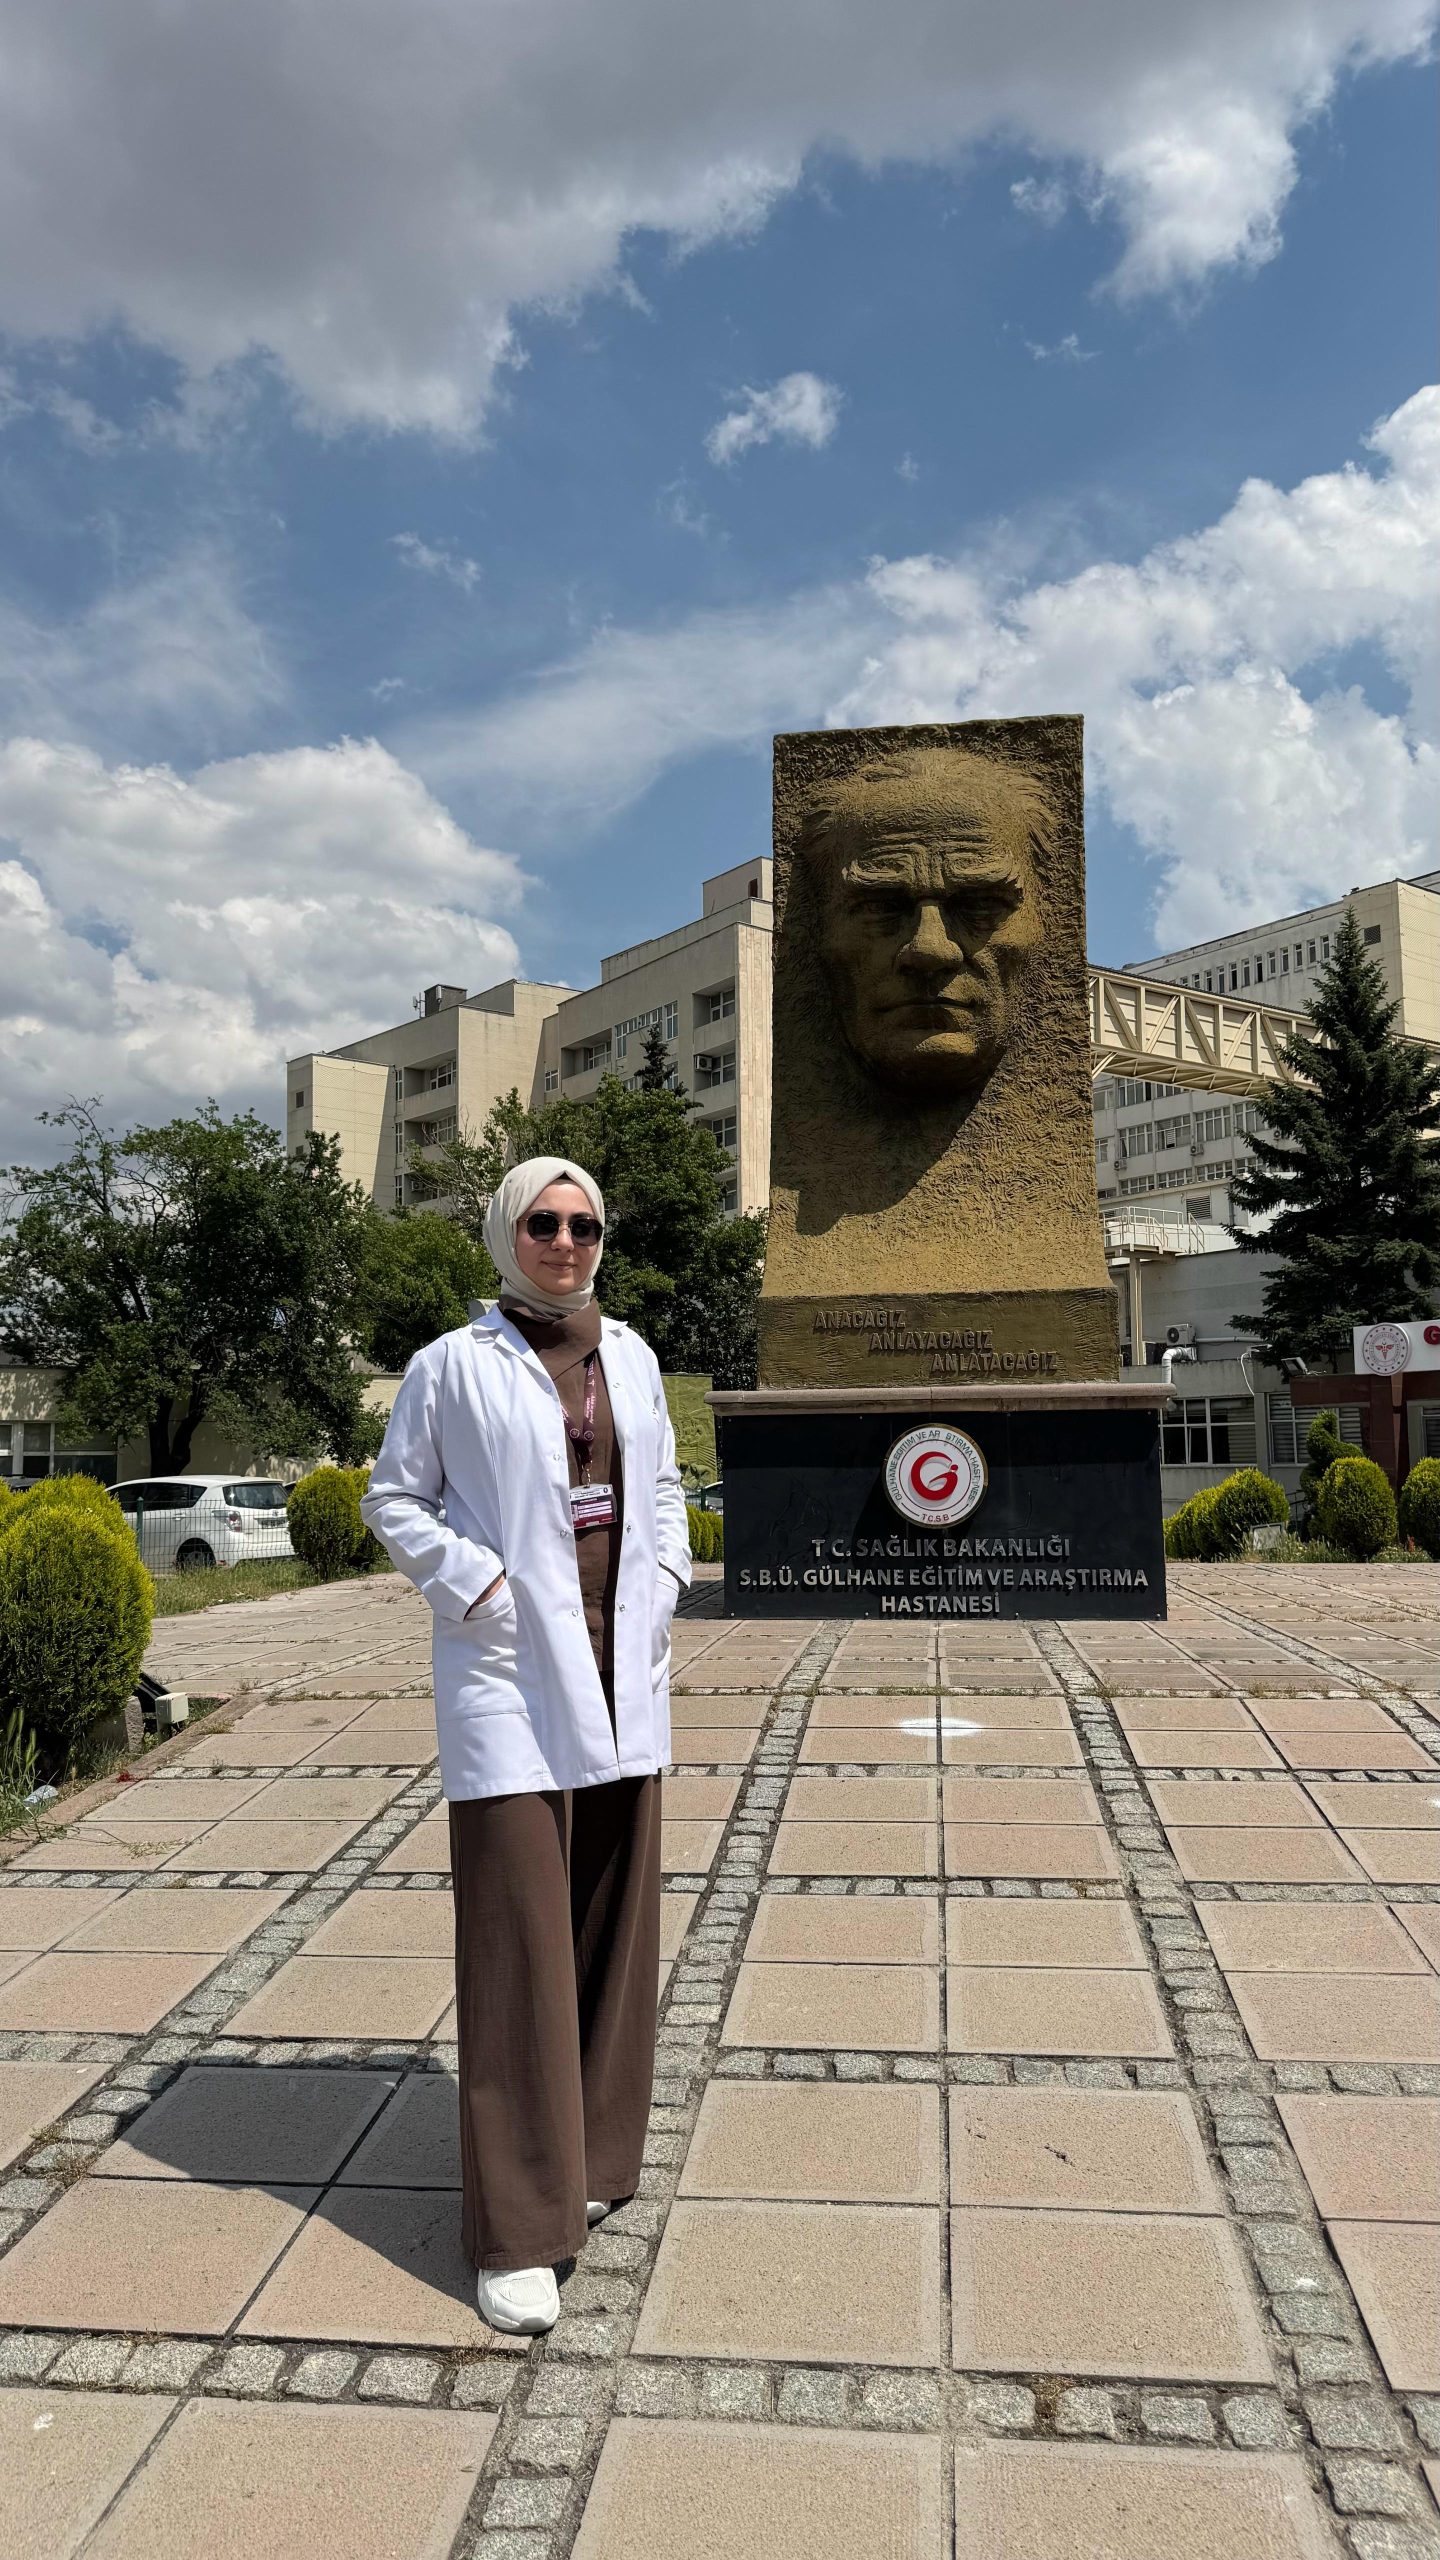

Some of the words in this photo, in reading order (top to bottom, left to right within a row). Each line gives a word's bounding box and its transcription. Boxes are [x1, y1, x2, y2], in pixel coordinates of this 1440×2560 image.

[870, 1327, 993, 1350] ANLAYACAĞIZ
[931, 1349, 1058, 1372] ANLATACAĞIZ
[856, 1535, 939, 1557] SAĞLIK
[943, 1535, 1070, 1557] BAKANLIĞI
[740, 1565, 799, 1586] S.B.Ü.
[803, 1565, 905, 1586] GÜLHANE
[910, 1565, 983, 1586] EĞİTİM
[987, 1568, 1014, 1586] VE
[1019, 1568, 1149, 1590] ARAŞTIRMA
[881, 1592, 1000, 1613] HASTANESİ
